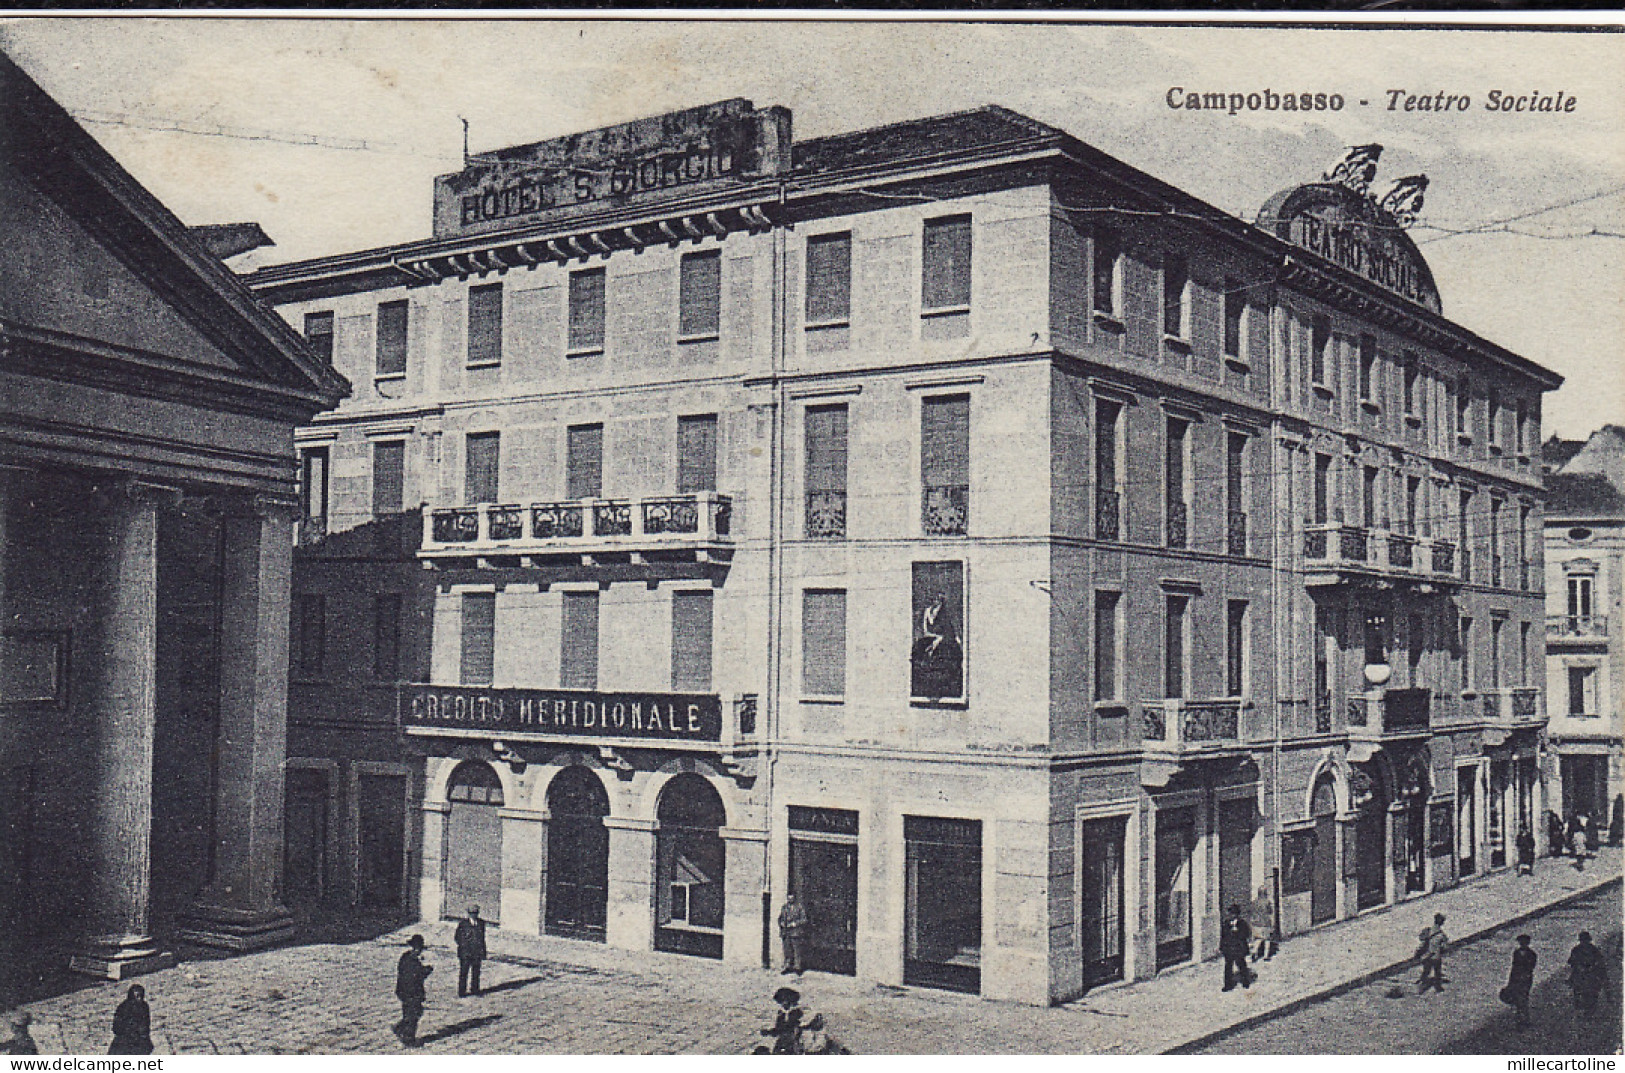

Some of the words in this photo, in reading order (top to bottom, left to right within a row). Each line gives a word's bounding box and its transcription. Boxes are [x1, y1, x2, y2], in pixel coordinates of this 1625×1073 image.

[461, 178, 555, 226] HOTEL
[412, 693, 504, 721] CREDITO
[520, 700, 701, 731] MERIDIONALE
